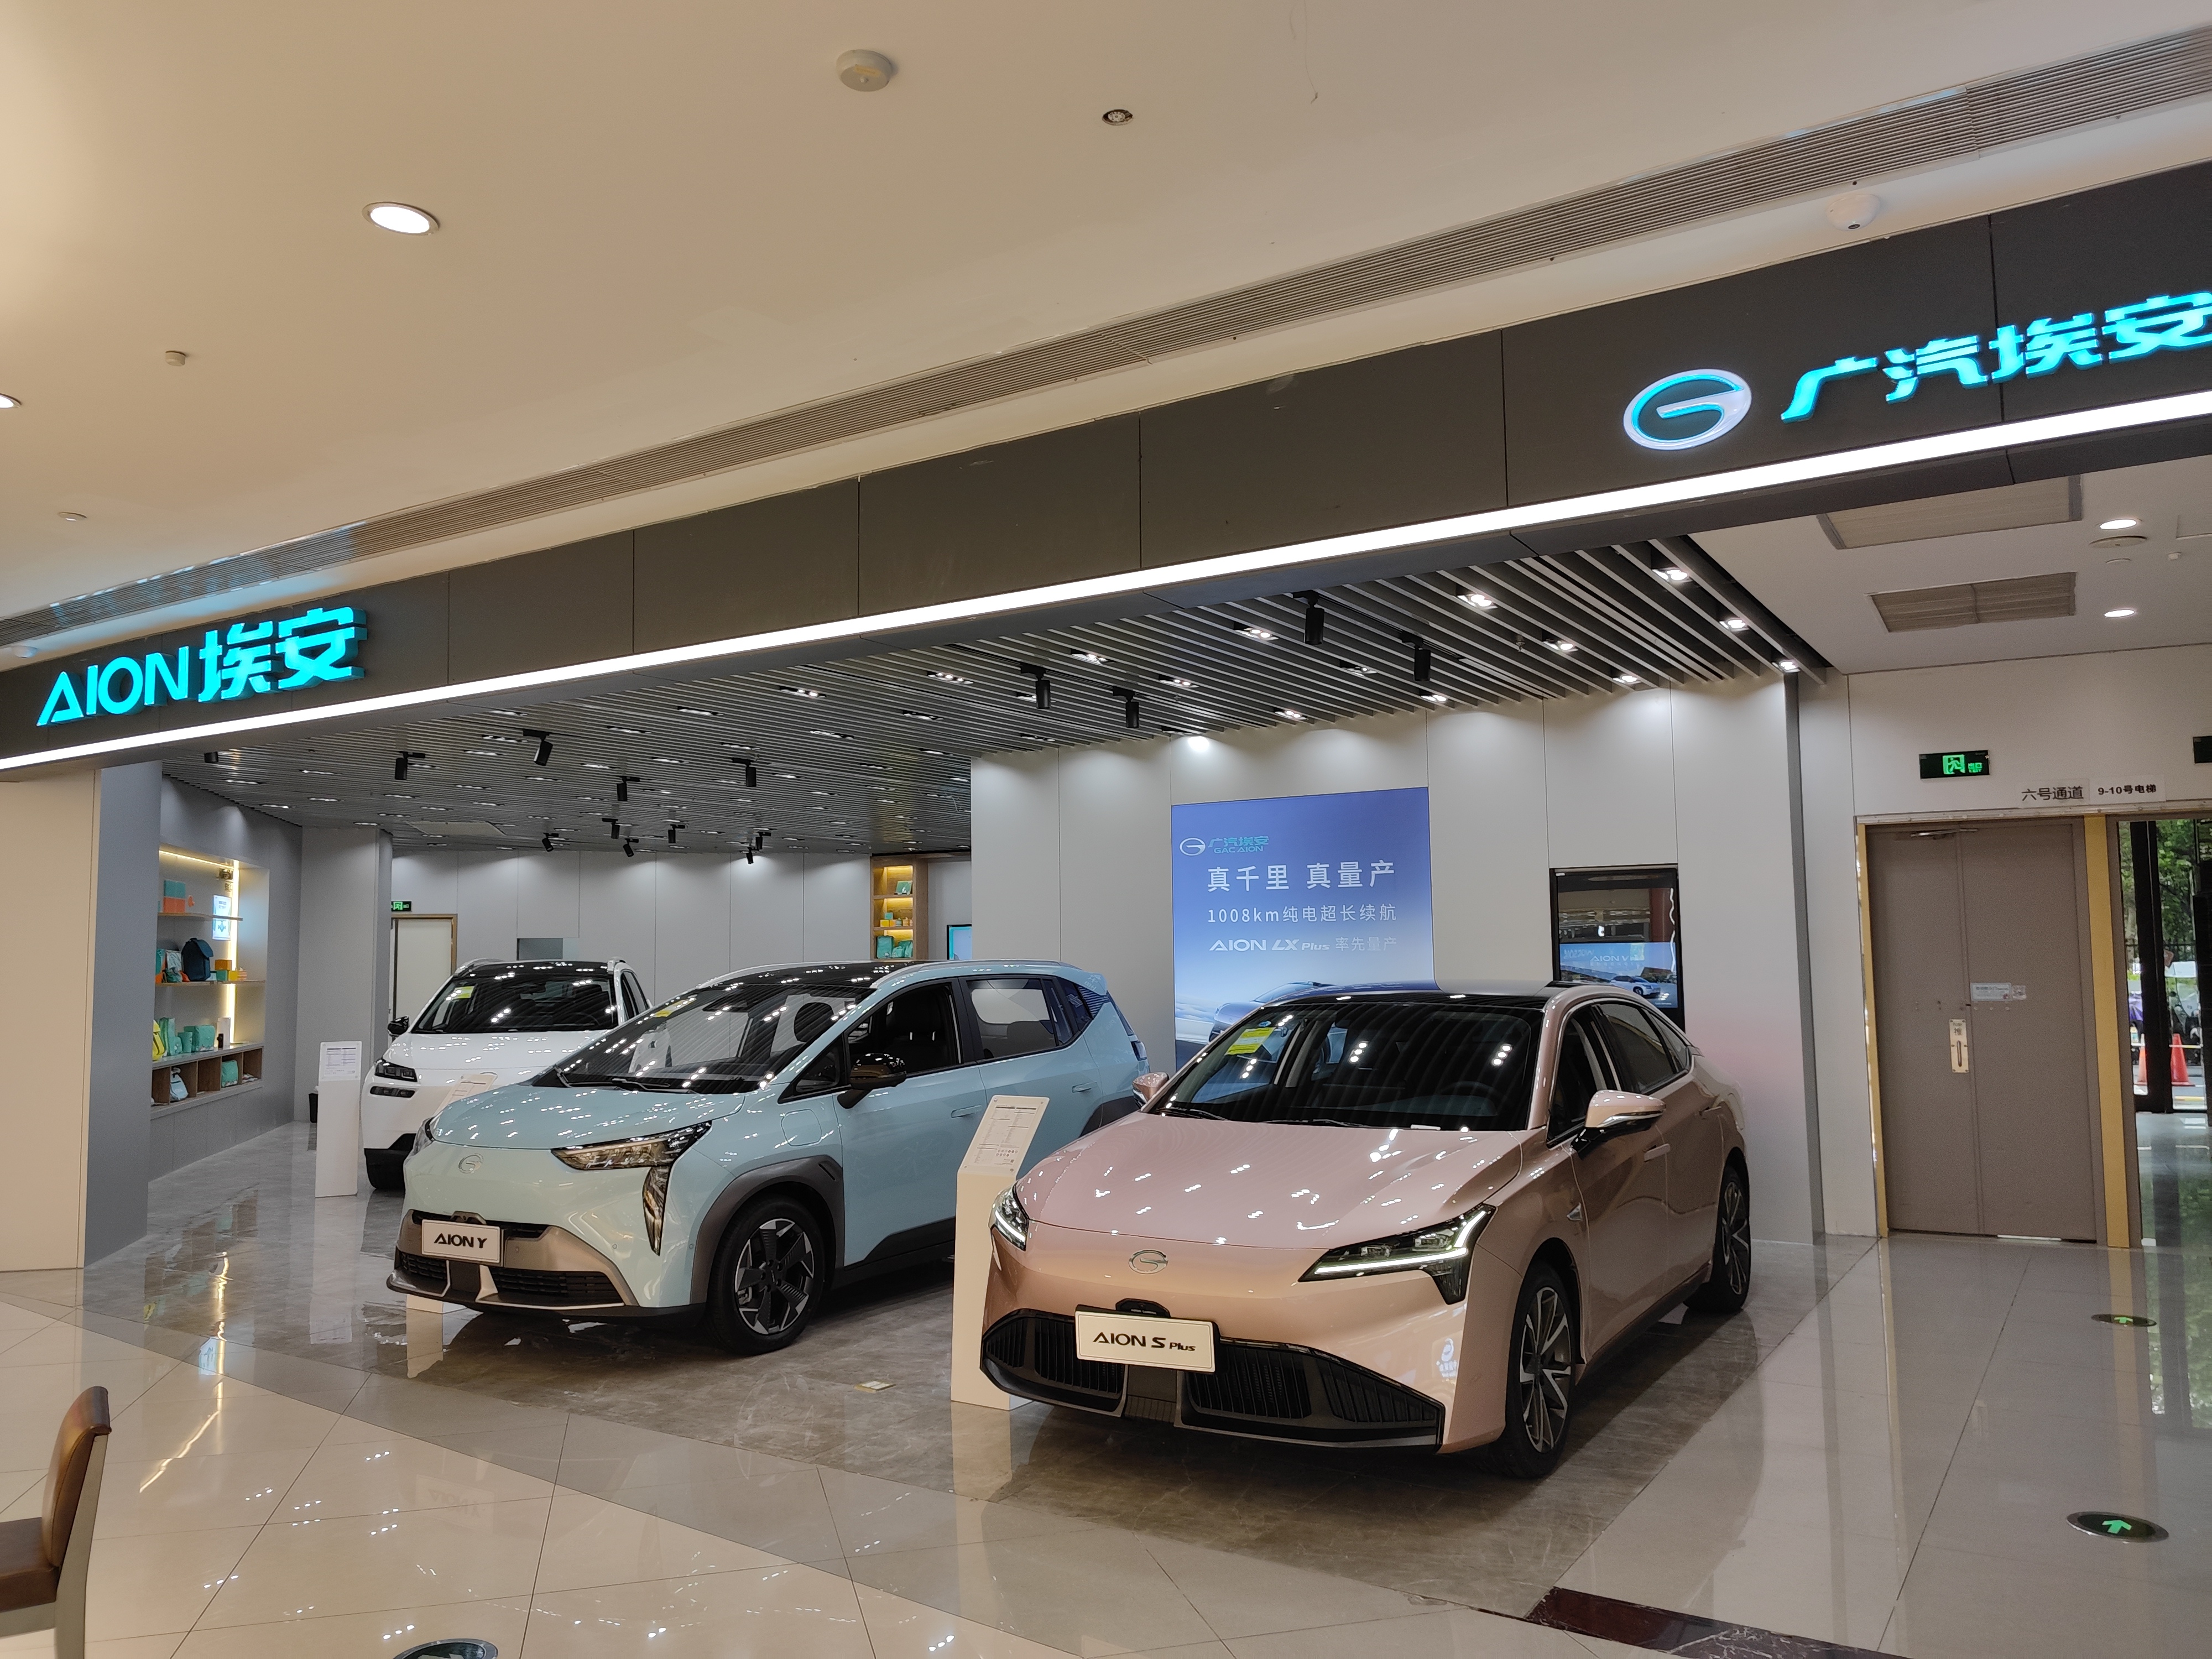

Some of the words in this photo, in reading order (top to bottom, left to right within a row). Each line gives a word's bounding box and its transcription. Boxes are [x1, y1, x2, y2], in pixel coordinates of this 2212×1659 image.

[1780, 291, 2212, 422] 广汽埃安
[2021, 786, 2084, 801] 六号通道
[2098, 784, 2157, 795] 9-10号电梯
[1208, 836, 1269, 848] 广汽埃安
[1207, 865, 1290, 892] 真千里
[1306, 860, 1395, 889] 真量产
[1208, 903, 1396, 922] 1008km纯电超长续航
[1209, 939, 1266, 952] AION
[1272, 939, 1300, 951] LX
[1302, 942, 1330, 951] Plus
[1335, 937, 1397, 952] 率先量产
[434, 1233, 474, 1248] AION
[477, 1238, 487, 1249] Y
[1093, 1332, 1146, 1347] AION
[1151, 1337, 1166, 1349] S
[1170, 1342, 1196, 1351] Plus
